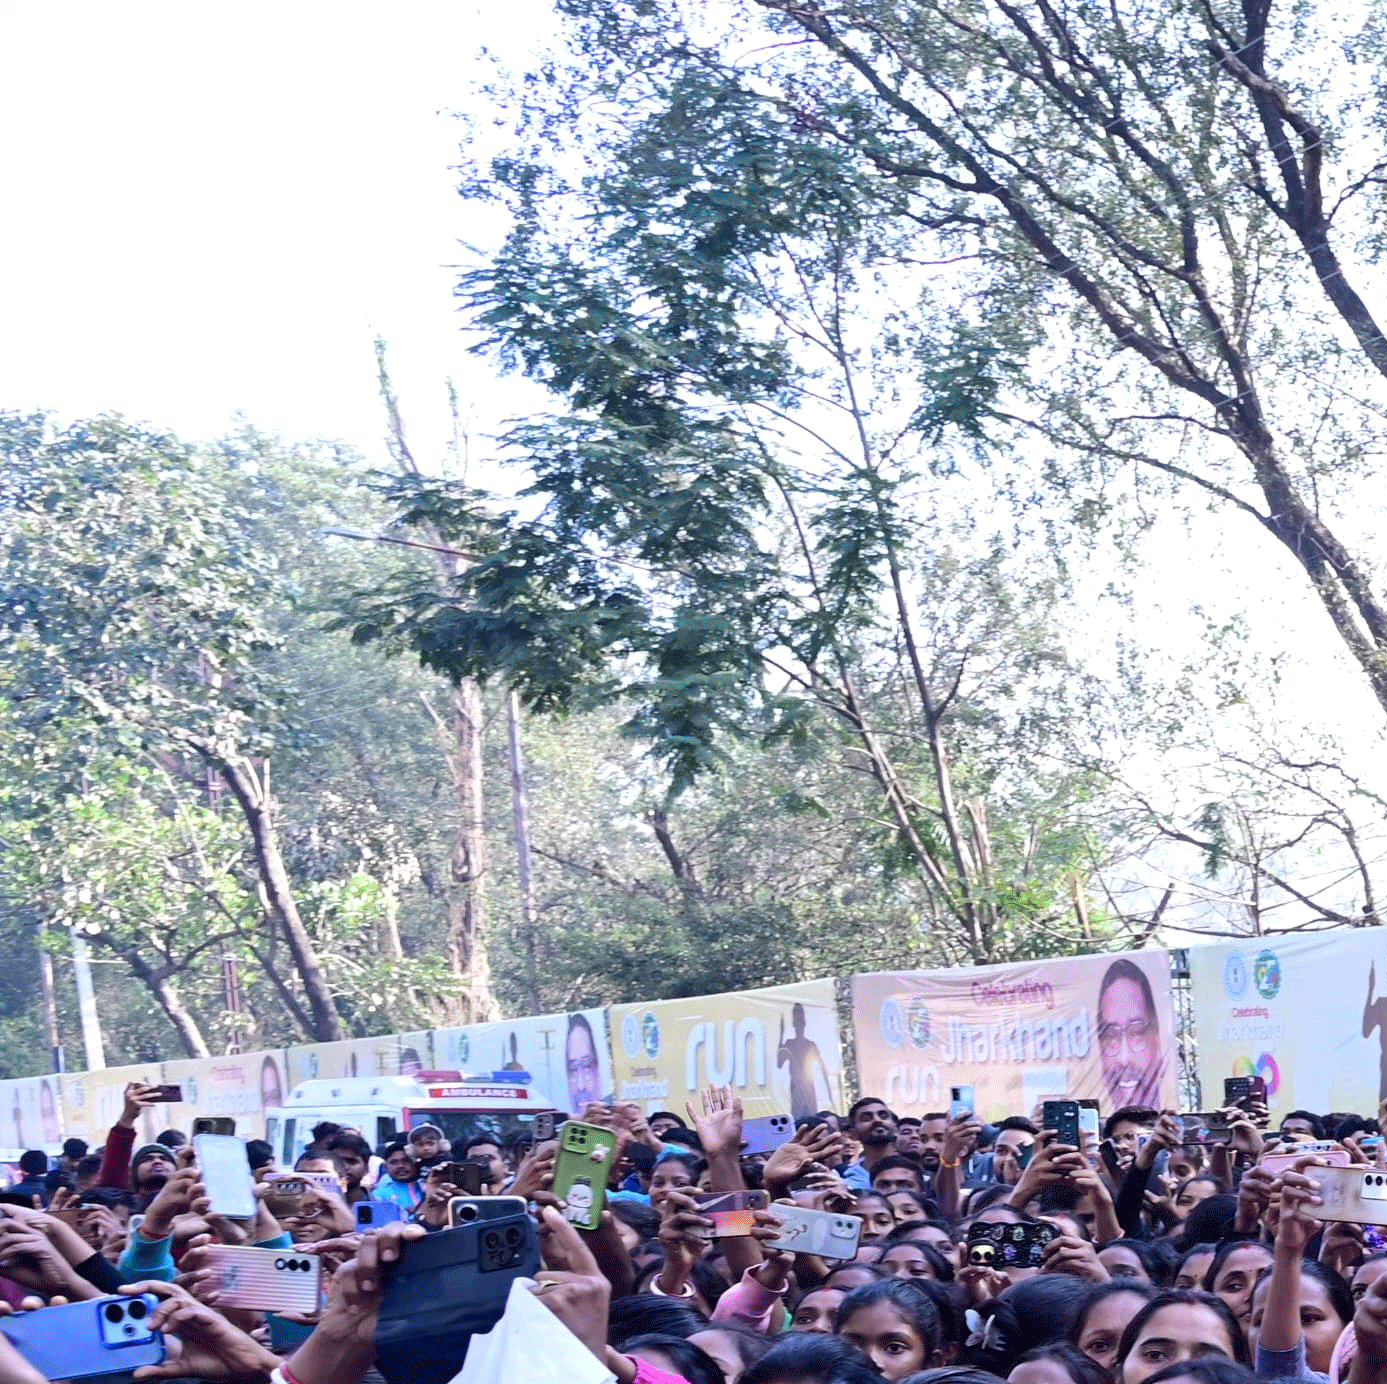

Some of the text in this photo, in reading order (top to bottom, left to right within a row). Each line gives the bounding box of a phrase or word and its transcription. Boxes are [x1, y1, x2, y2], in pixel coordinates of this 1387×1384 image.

[971, 978, 1054, 1010] Celebrating
[686, 1017, 766, 1090] run
[940, 1008, 1090, 1064] Jharkhand
[441, 1088, 517, 1098] AMBULANCE
[886, 1063, 941, 1103] run
